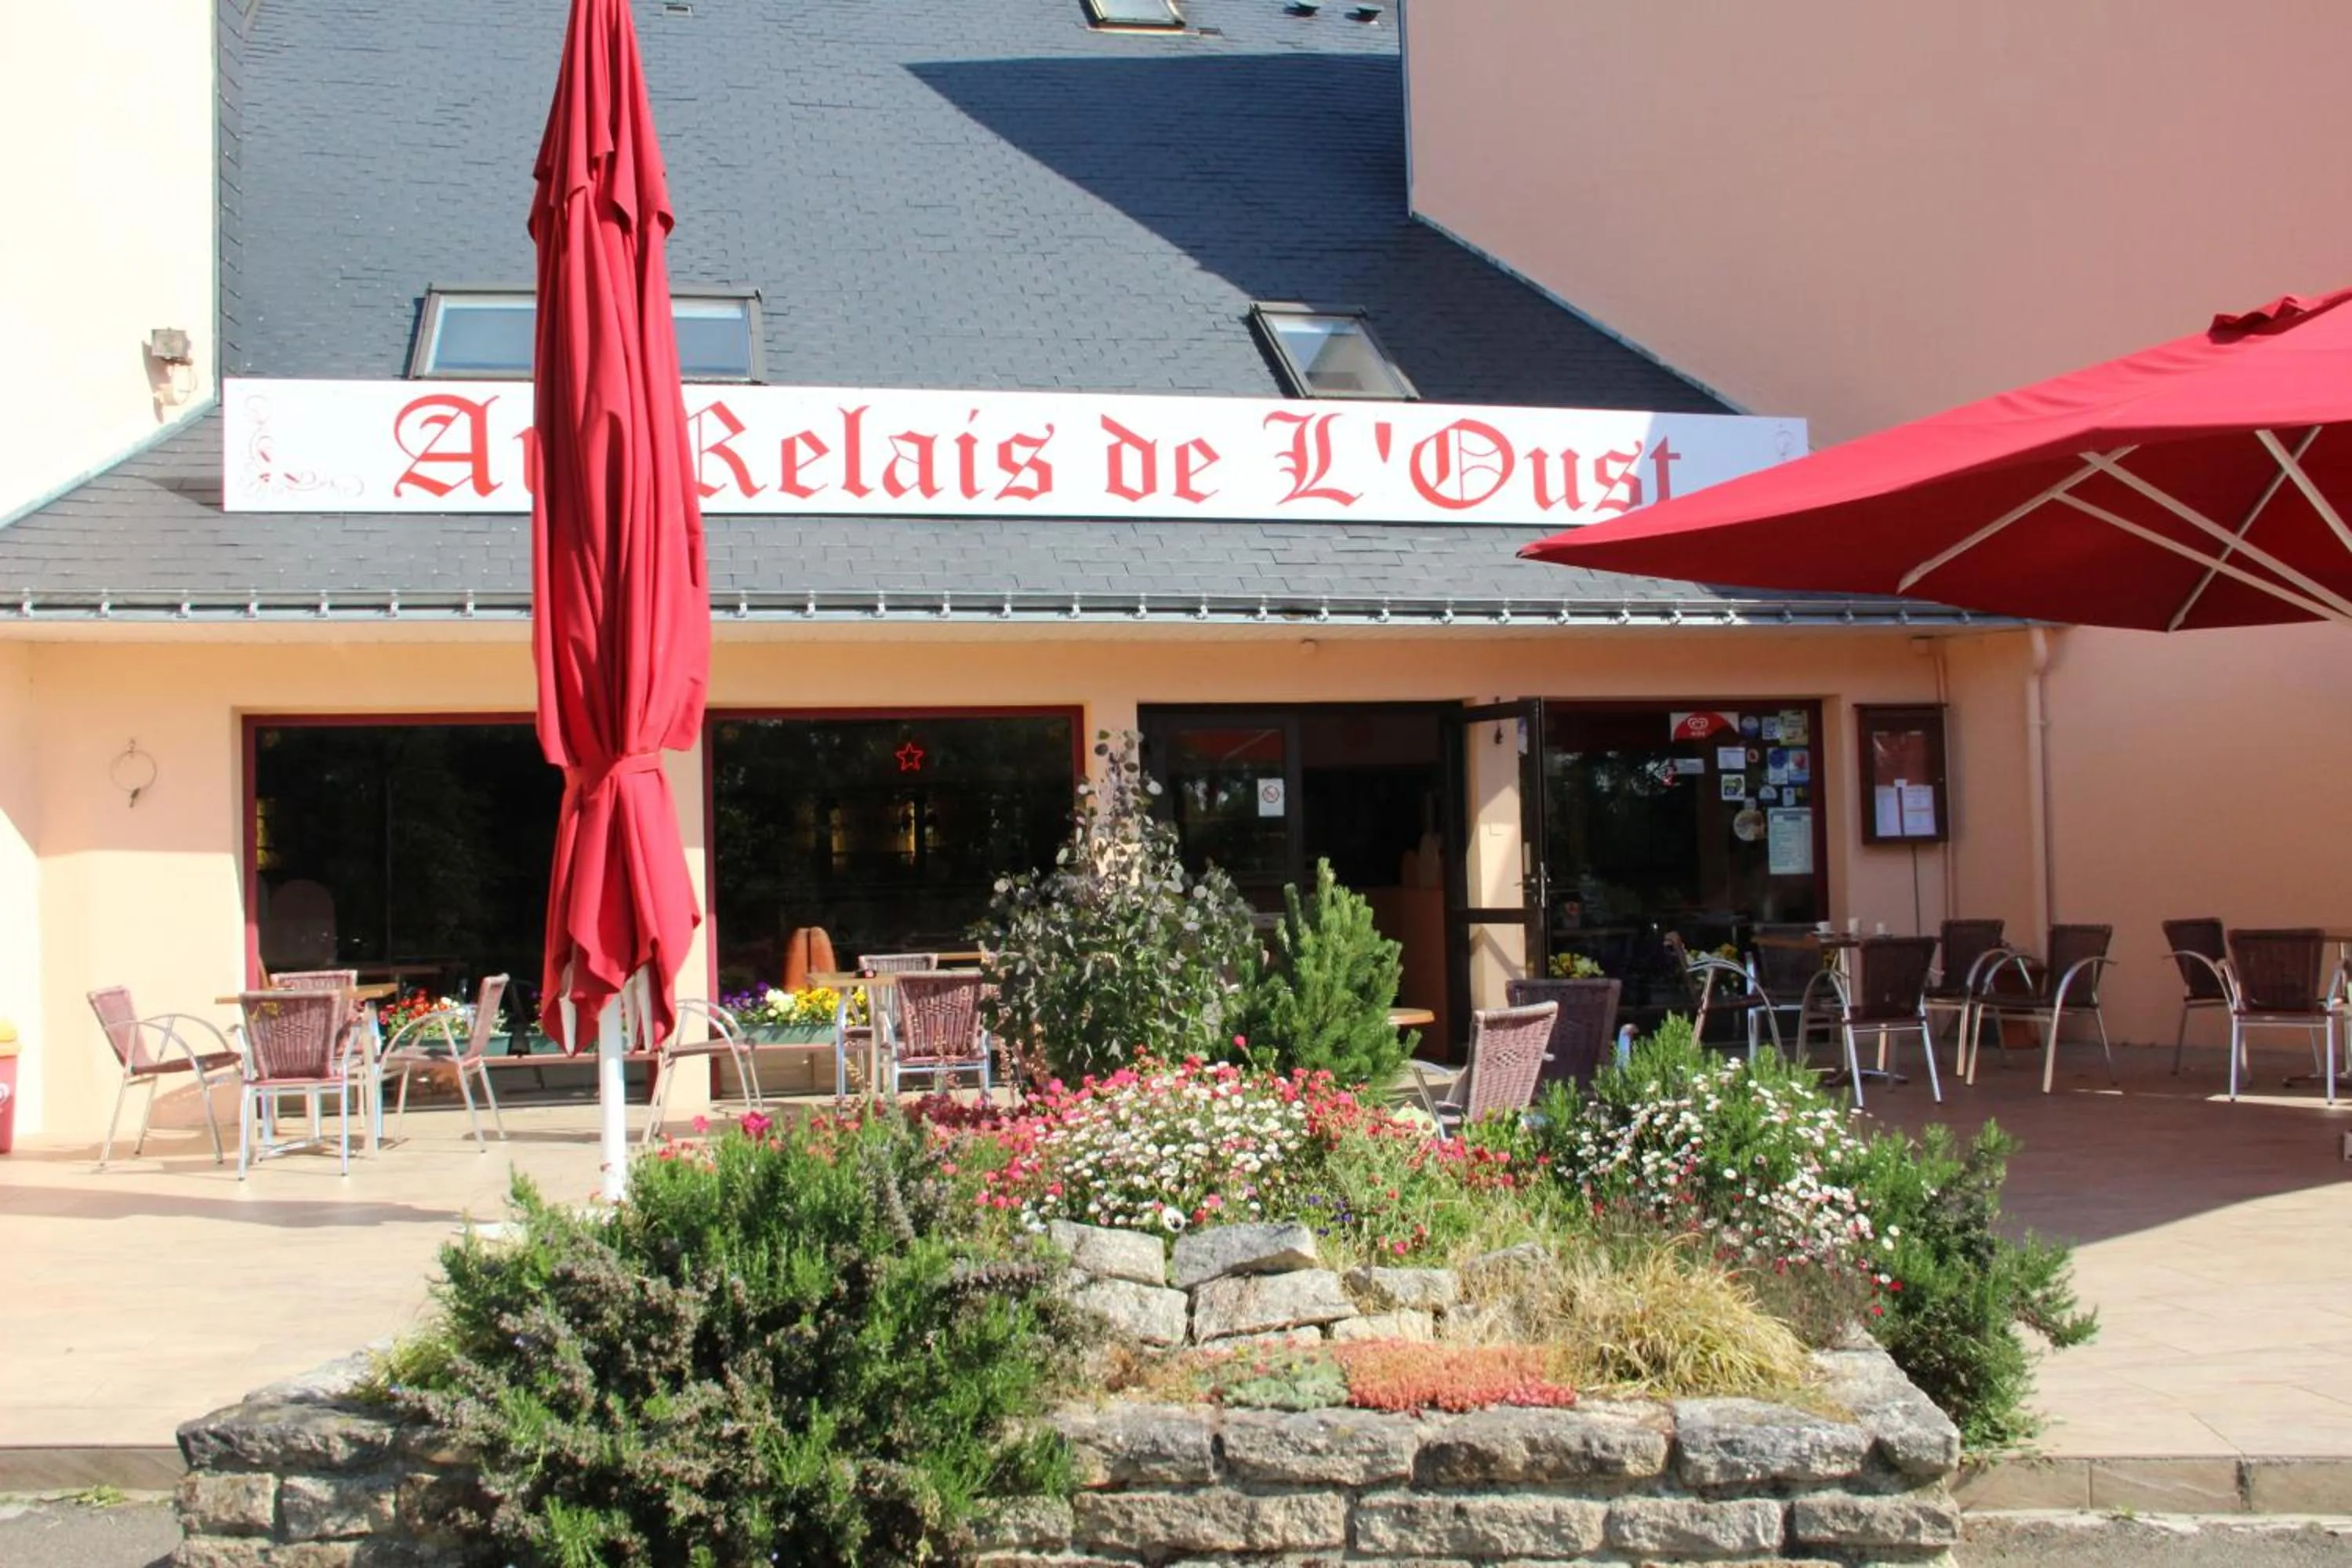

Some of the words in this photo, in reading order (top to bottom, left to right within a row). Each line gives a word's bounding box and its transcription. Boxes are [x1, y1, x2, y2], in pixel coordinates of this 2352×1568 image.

[687, 400, 1055, 502] Relais
[1100, 413, 1221, 504] de
[1263, 410, 1682, 513] L'Oust
